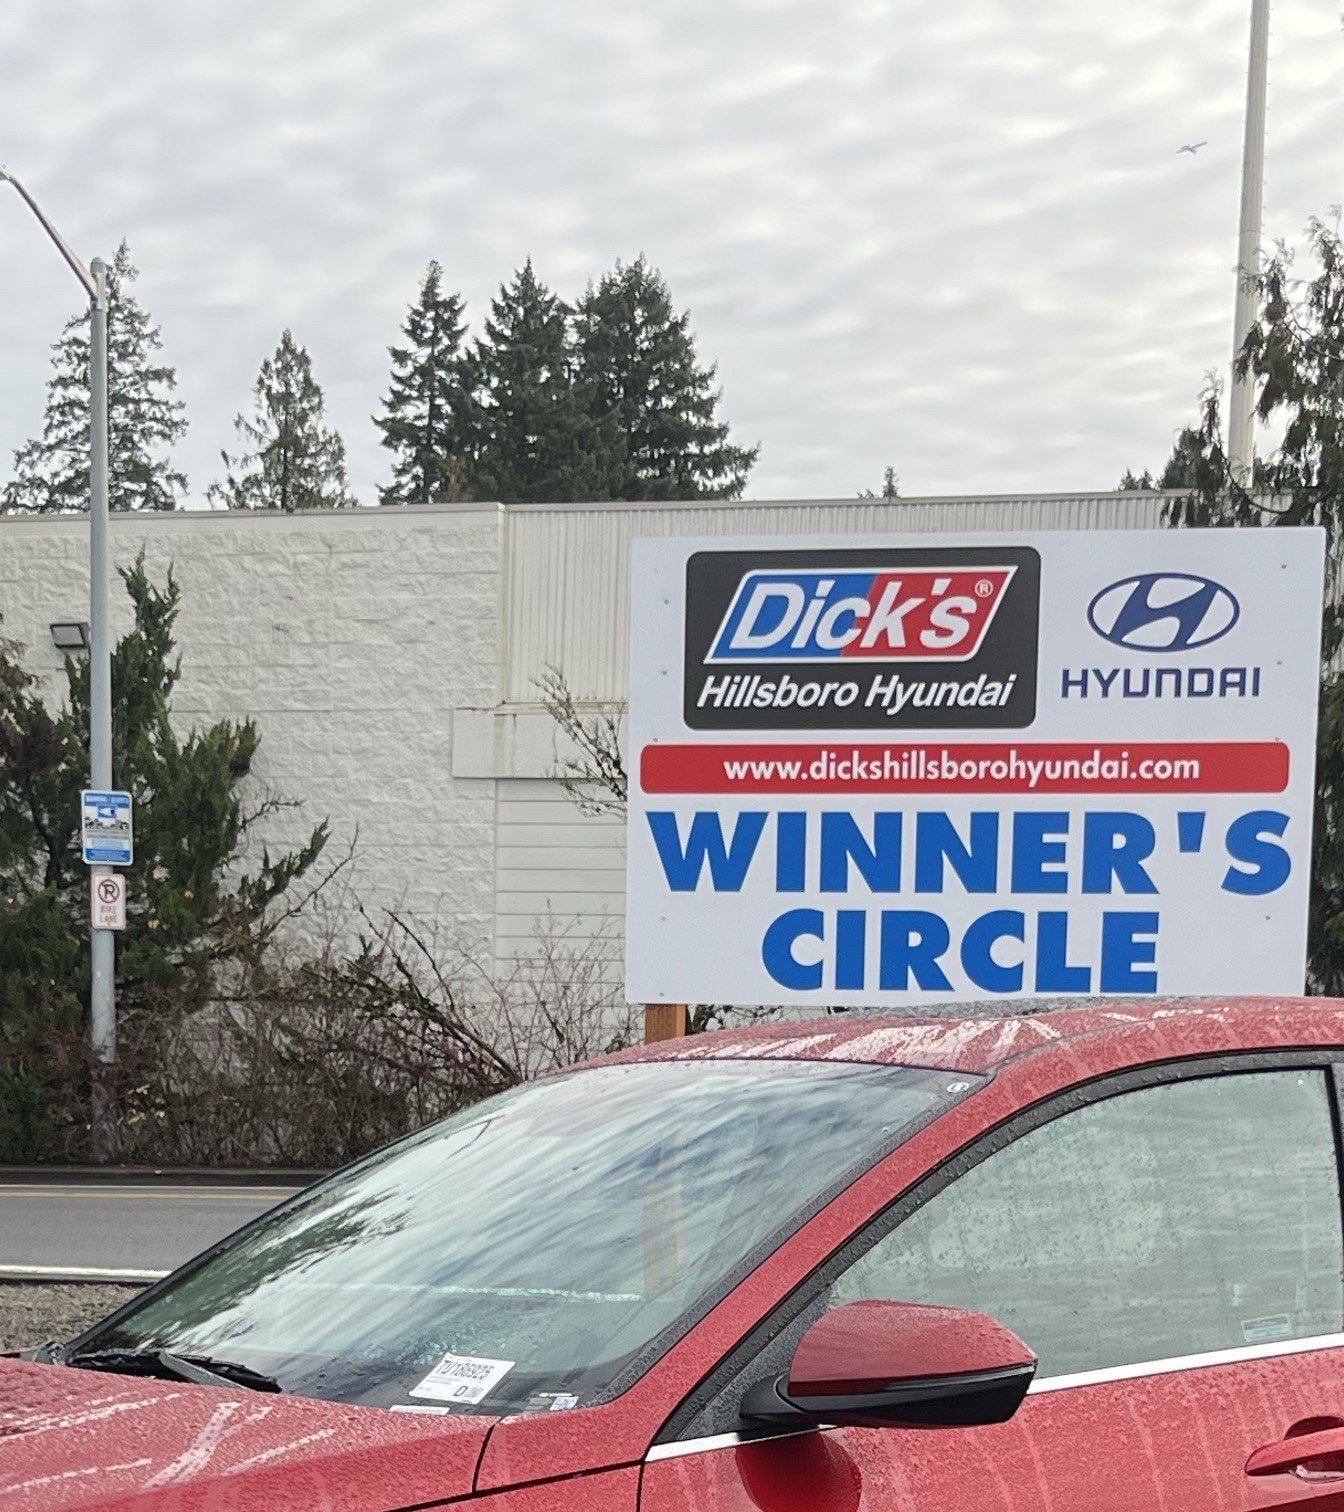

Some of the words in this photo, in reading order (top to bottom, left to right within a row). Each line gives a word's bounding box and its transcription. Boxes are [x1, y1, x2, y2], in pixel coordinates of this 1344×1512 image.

[729, 577, 978, 649] Dick's
[696, 674, 859, 708] Hillsboro
[864, 673, 1017, 715] Hyundai
[1061, 666, 1260, 699] HYUNDAI
[723, 749, 1200, 788] www.dickshillsborohyundai.com
[645, 810, 1292, 896] WINNER'S
[761, 907, 1160, 994] CIRCLE
